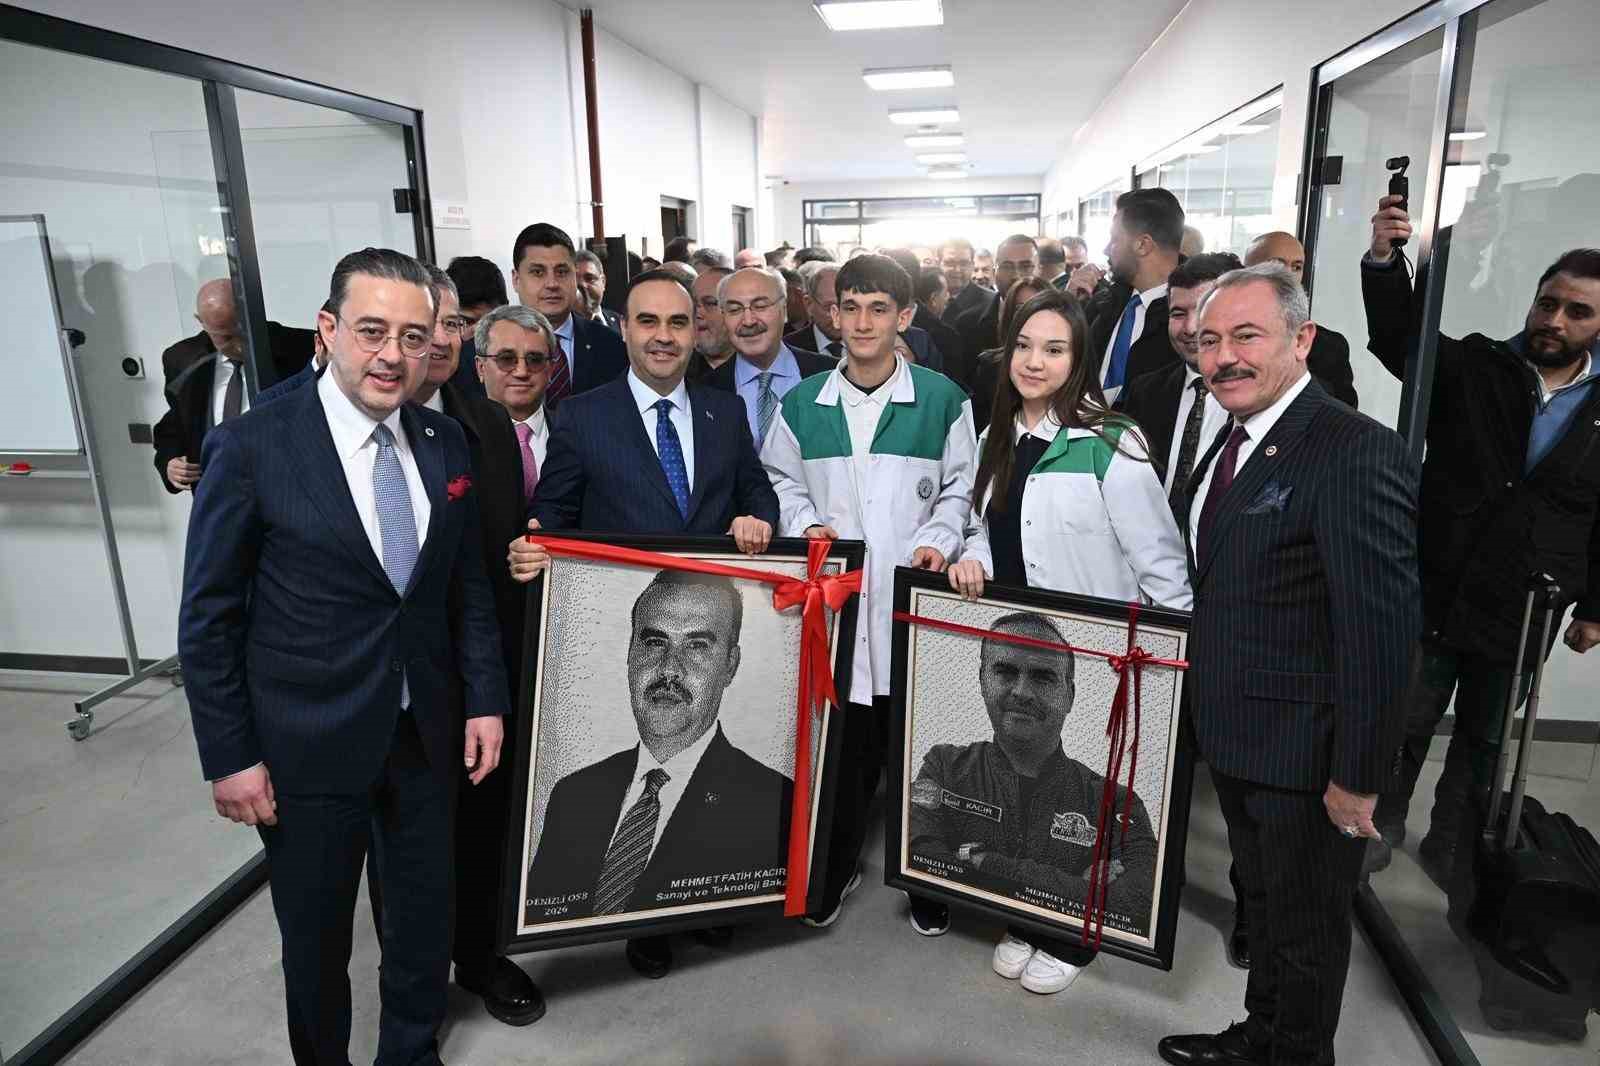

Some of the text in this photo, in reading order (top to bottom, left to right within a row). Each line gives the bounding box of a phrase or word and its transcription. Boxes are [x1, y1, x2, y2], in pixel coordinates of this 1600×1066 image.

[670, 875, 720, 889] MEHMET
[656, 878, 787, 902] Sanayi ve Teknoloji Bak
[567, 892, 589, 902] OSB
[544, 906, 568, 916] 2026
